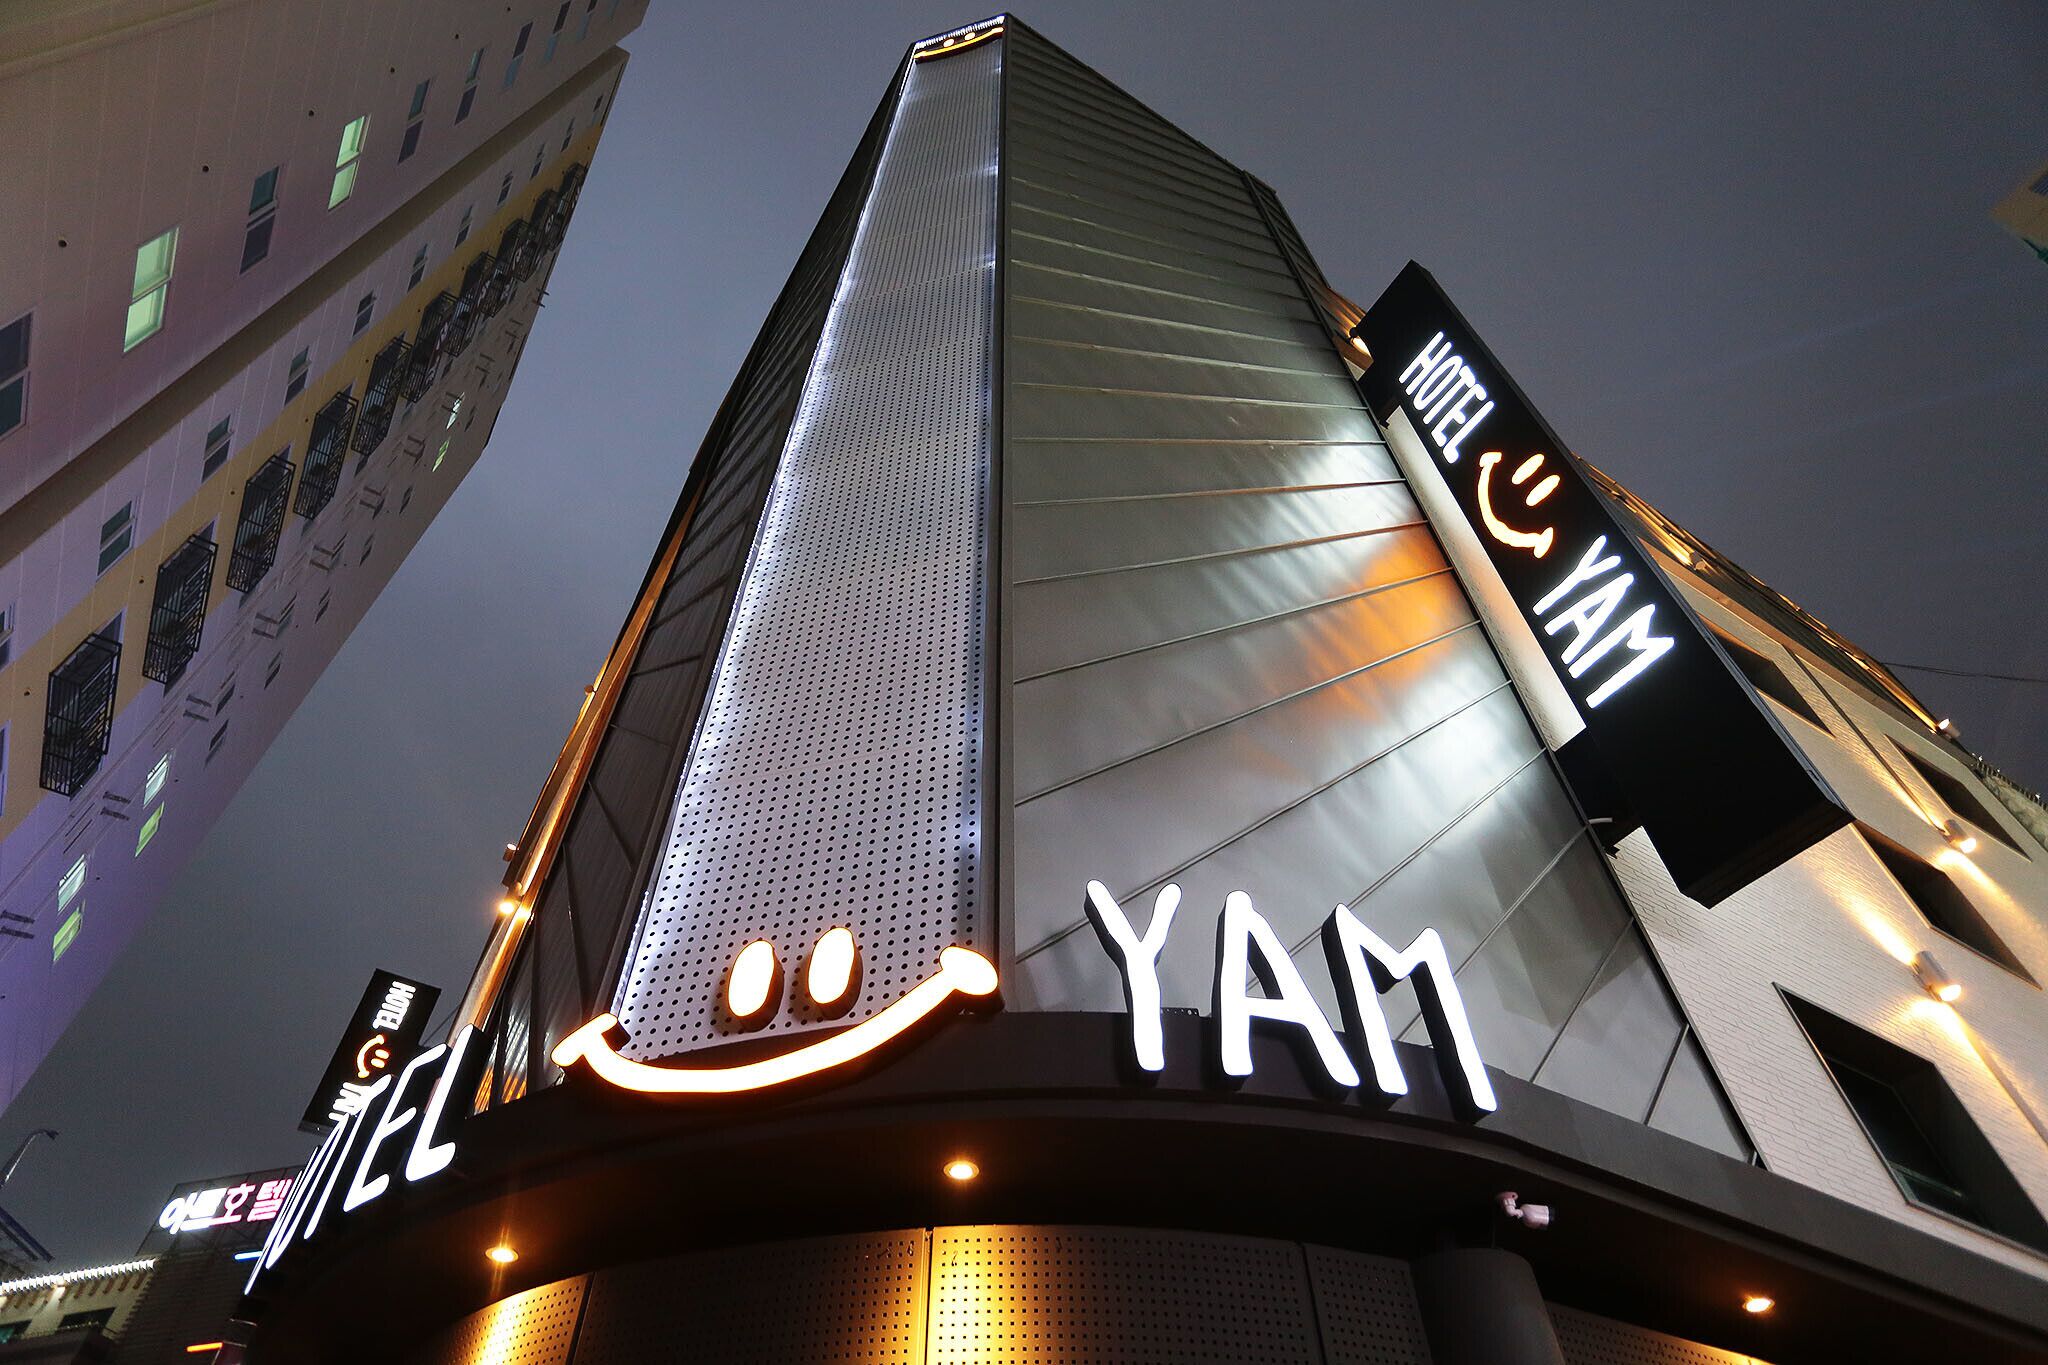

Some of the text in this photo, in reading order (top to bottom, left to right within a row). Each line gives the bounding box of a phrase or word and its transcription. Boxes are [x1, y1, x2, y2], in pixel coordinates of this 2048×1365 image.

[1398, 330, 1675, 709] HOTEL YAM
[372, 980, 416, 1031] HOTEL
[1085, 879, 1498, 1113] YAM
